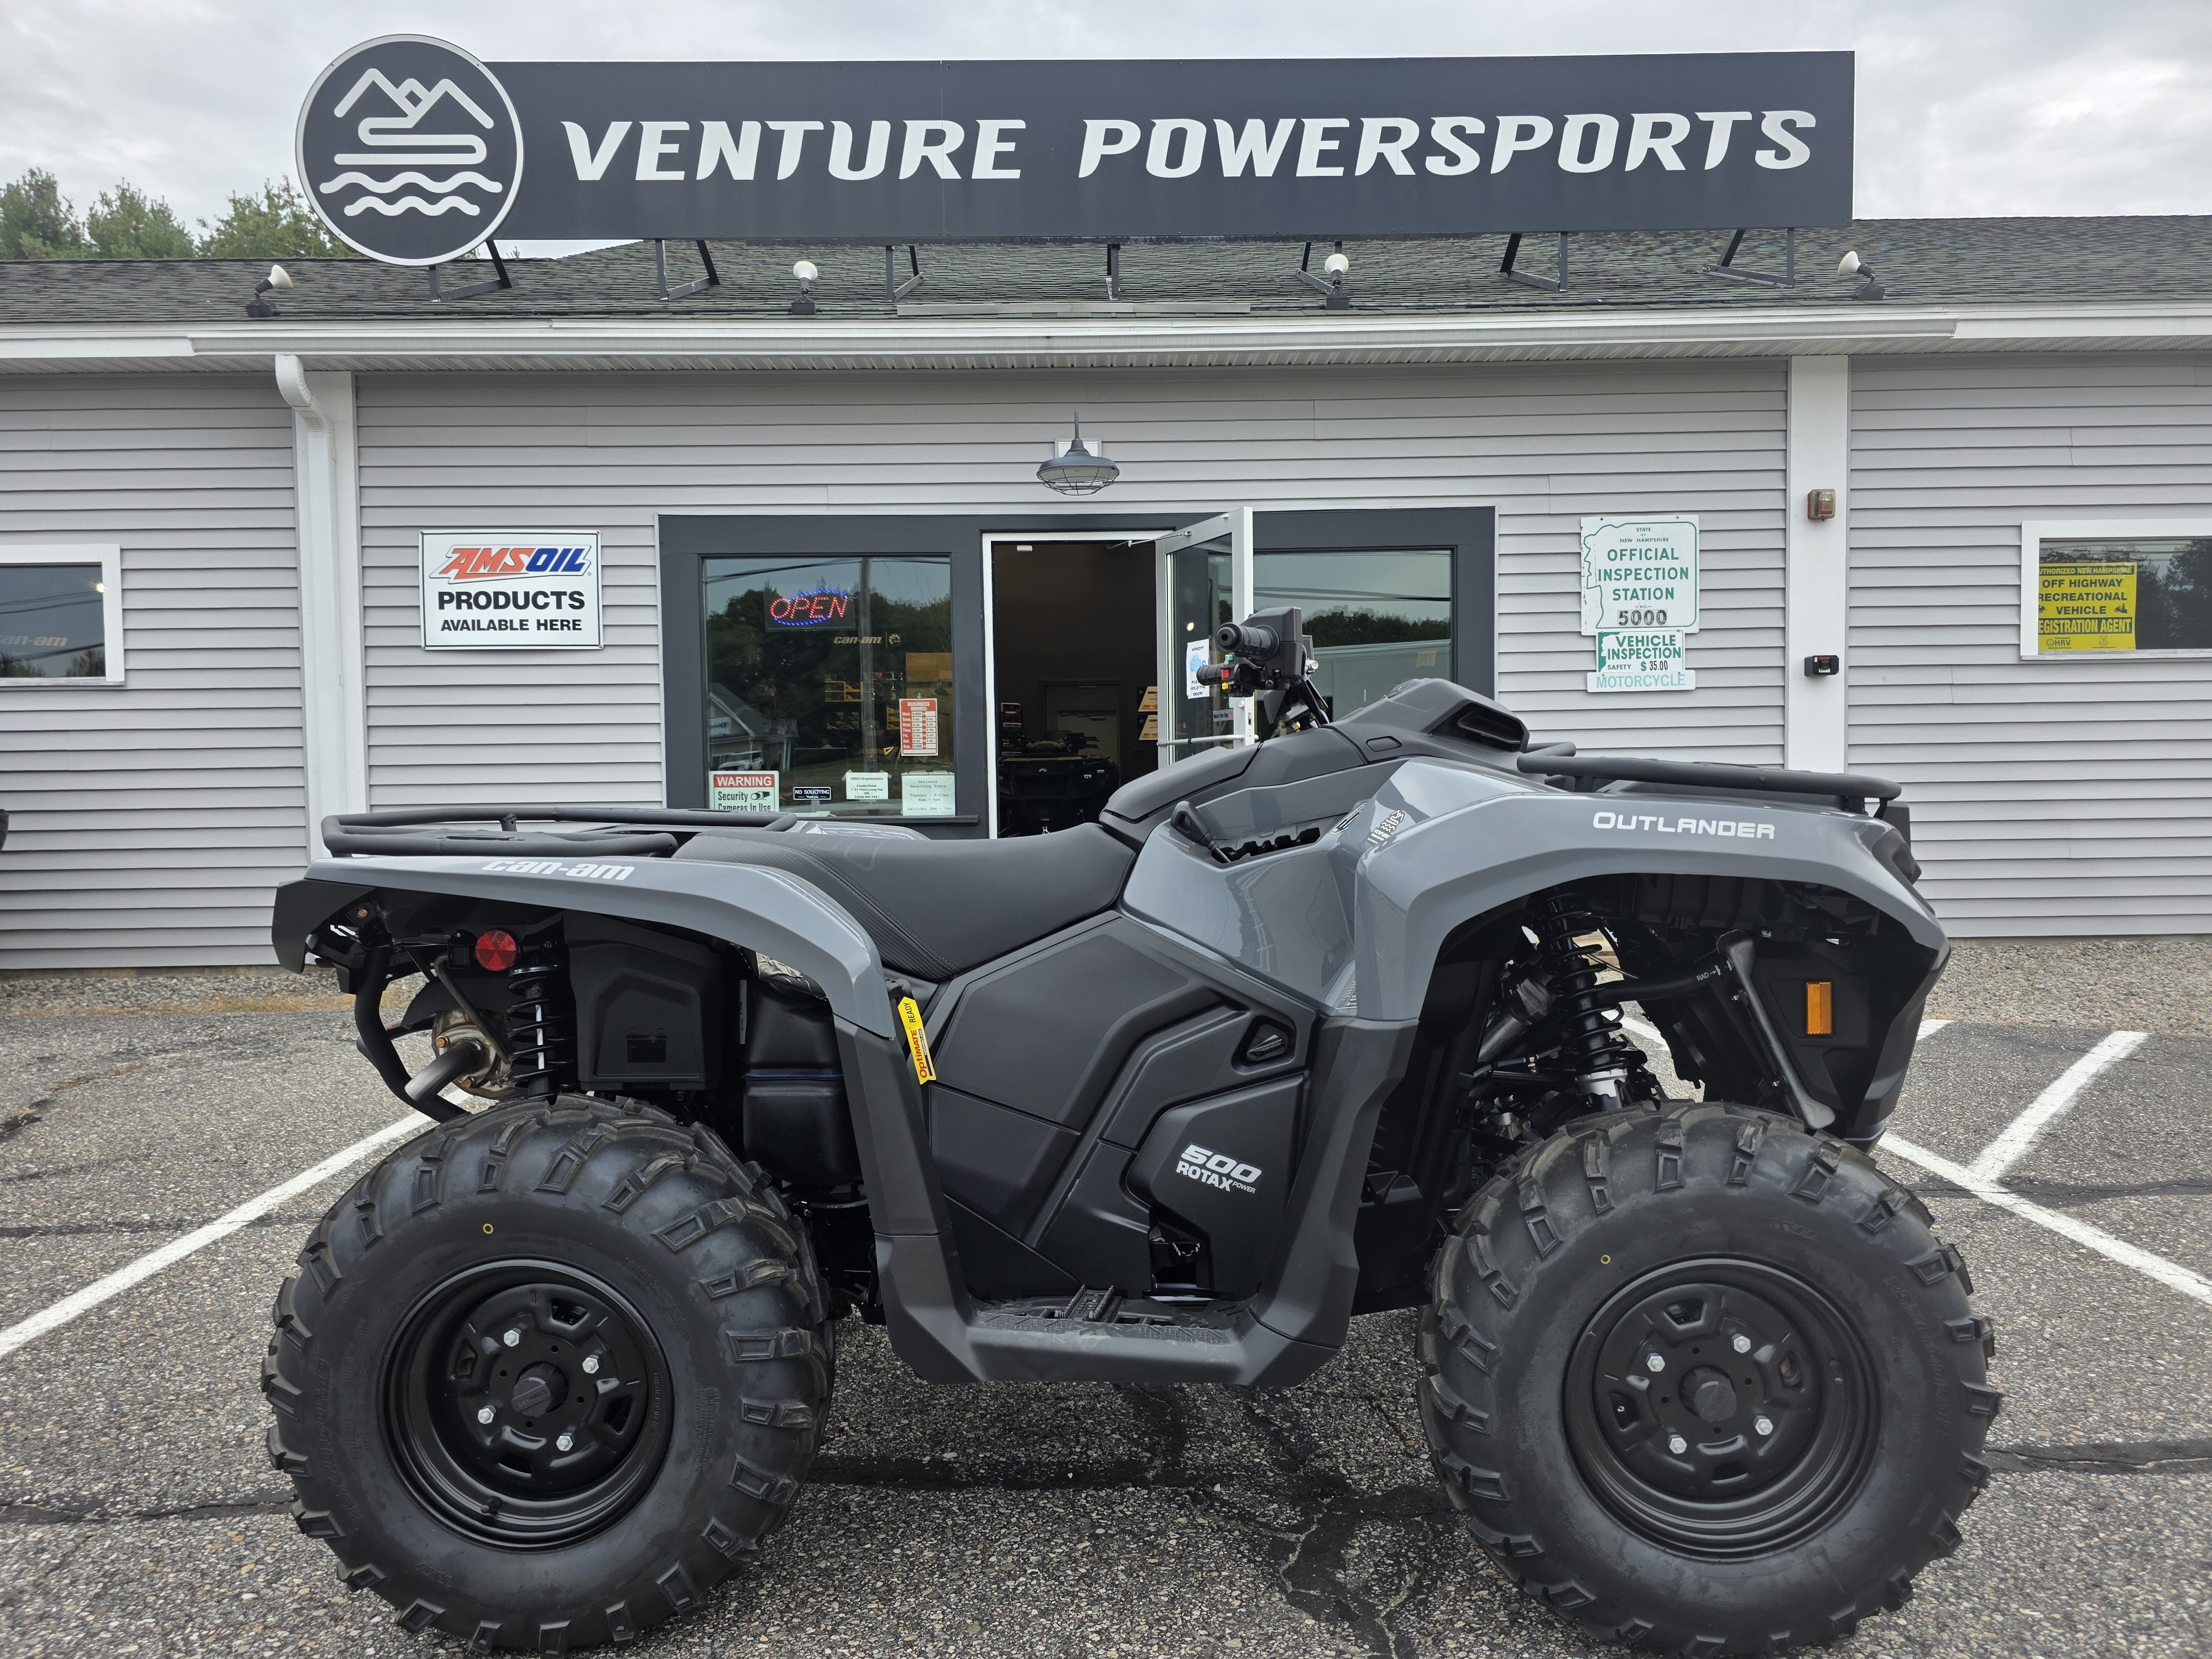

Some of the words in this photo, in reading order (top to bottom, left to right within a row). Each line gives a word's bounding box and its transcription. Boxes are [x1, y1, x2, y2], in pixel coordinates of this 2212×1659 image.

[561, 119, 1026, 181] VENTURE
[1078, 110, 1817, 178] POWERSPORTS
[1607, 547, 1679, 561] OFFICIAL
[439, 548, 586, 580] AMSOIL
[1598, 567, 1688, 581] INSPECTION
[2042, 580, 2065, 588] OFF
[2069, 578, 2124, 587] HIGHWAY
[438, 591, 585, 610] PRODUCTS
[1613, 587, 1674, 601] STATION
[2039, 592, 2127, 602] RECREATIONAL
[770, 596, 848, 618] OPEN
[2056, 606, 2106, 615] VEHICLE
[1619, 609, 1667, 626] 5000
[441, 619, 529, 632] AVAILABLE
[536, 619, 582, 630] HERE
[2100, 618, 2131, 633] AGENT
[833, 636, 882, 644] can-am
[1615, 635, 1676, 648] VEHICLE
[1608, 647, 1681, 660] INSPECTION
[1649, 660, 1668, 671] 35.00
[1596, 674, 1686, 688] MOTORCYCLE
[717, 776, 772, 786] WARNING
[718, 791, 748, 802] Security
[718, 803, 748, 812] Cameras
[750, 803, 757, 812] In
[759, 803, 771, 812] Use
[1593, 812, 1775, 839] OUTLANDER
[482, 860, 635, 880] can-am
[1696, 972, 1709, 982] RAD
[903, 1002, 916, 1023] READY
[911, 1029, 927, 1078] OptiMATE
[1181, 1144, 1262, 1183] 500
[1176, 1160, 1234, 1192] ROTAX
[1232, 1181, 1256, 1194] POWER
